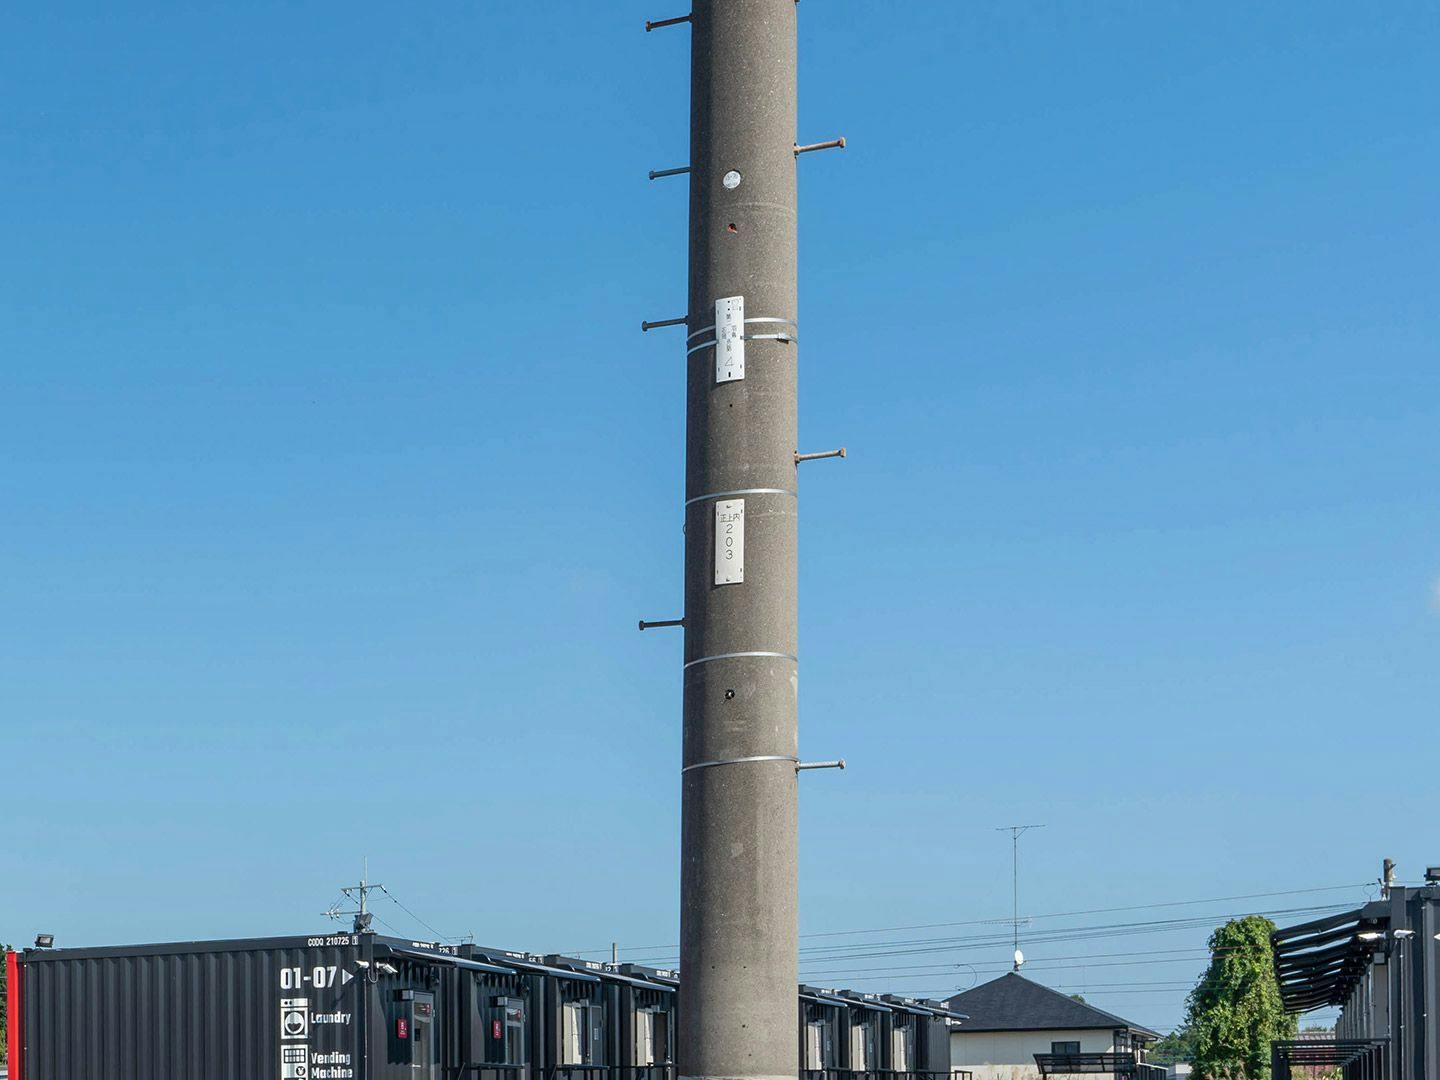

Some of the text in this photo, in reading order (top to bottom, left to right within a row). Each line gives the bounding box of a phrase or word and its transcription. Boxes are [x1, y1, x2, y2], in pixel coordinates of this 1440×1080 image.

[326, 936, 350, 946] 210725
[280, 966, 337, 990] 01-07
[311, 1010, 352, 1025] Laundry
[311, 1051, 351, 1065] Vending
[311, 1066, 354, 1080] Machine
